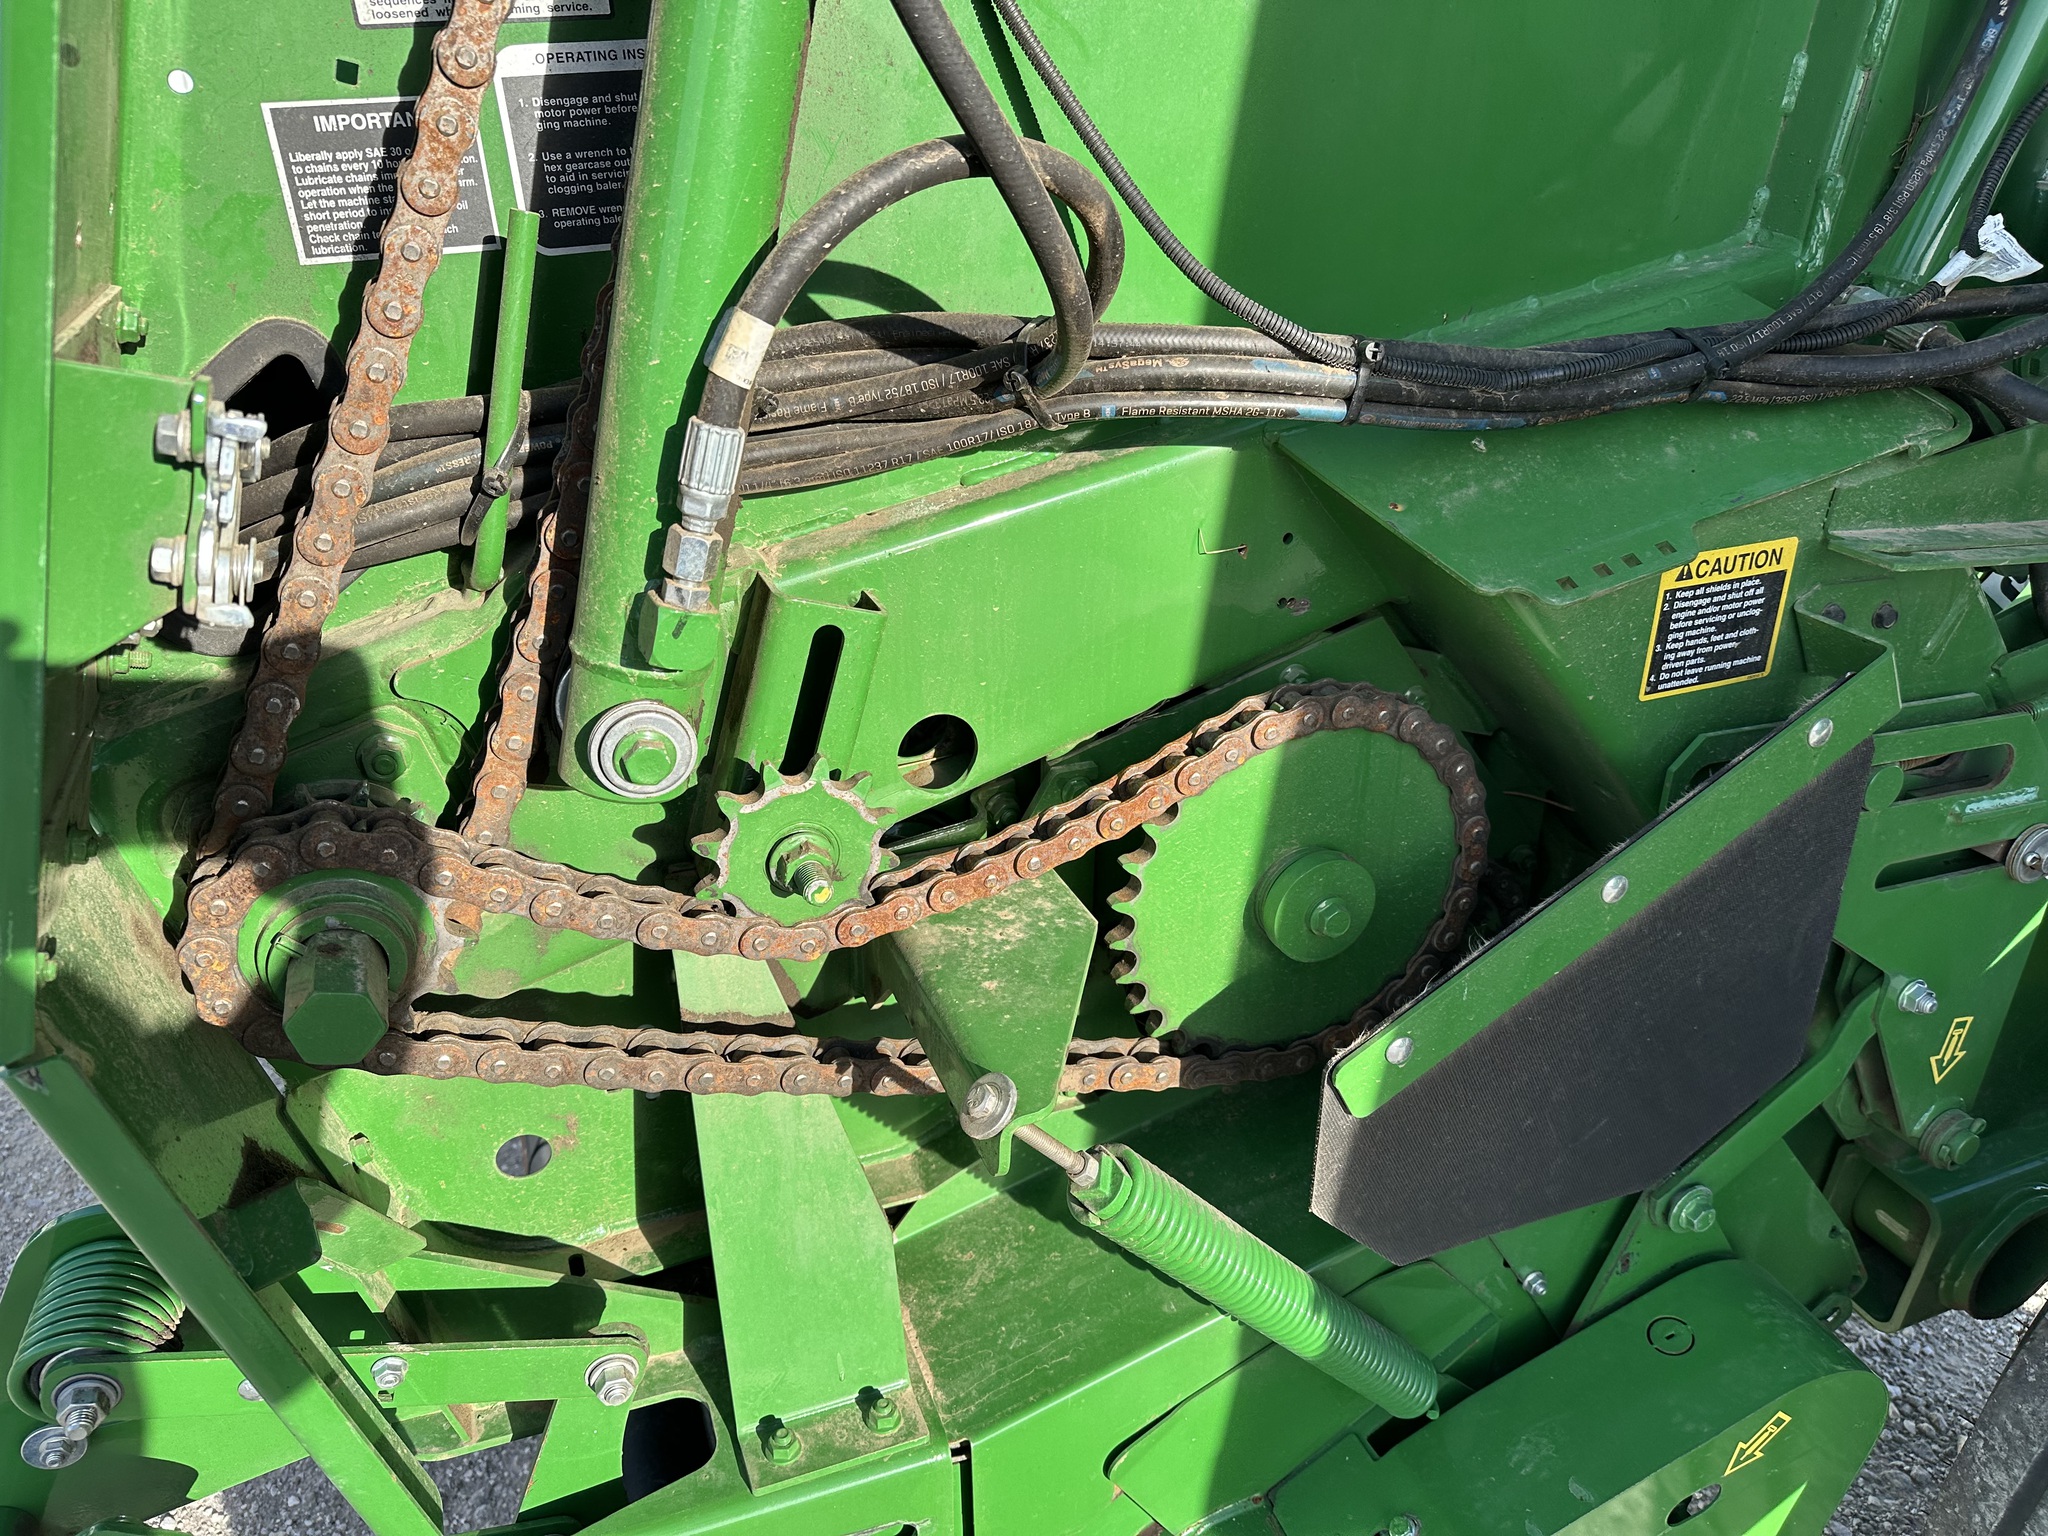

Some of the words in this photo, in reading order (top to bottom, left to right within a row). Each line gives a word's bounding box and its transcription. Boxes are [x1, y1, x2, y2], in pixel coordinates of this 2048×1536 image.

[371, 7, 429, 19] loosened
[547, 1, 593, 13] service.
[535, 49, 618, 64] OPERATING
[518, 98, 529, 108] 1.
[531, 94, 589, 108] Disengage
[592, 93, 611, 104] and
[615, 91, 638, 102] shut
[534, 107, 566, 119] motor
[569, 107, 601, 118] power
[605, 104, 638, 115] before
[536, 120, 560, 131] ging
[563, 117, 612, 129] machine.
[1932, 128, 1948, 150] 22.5
[288, 151, 333, 164] Liberally
[335, 150, 363, 162] apply
[365, 147, 388, 158] SAE
[390, 146, 402, 157] 30
[528, 153, 538, 162] 2.
[541, 152, 562, 161] Use
[565, 152, 572, 160] a
[575, 148, 613, 158] wrench
[616, 147, 627, 156] to
[1919, 149, 1937, 166] MPa
[291, 164, 303, 175] to
[305, 161, 339, 174] chains
[341, 161, 369, 173] every
[371, 159, 383, 169] 10
[544, 162, 563, 172] hex
[566, 158, 611, 172] gearcase
[295, 174, 343, 187] Lubricate
[344, 171, 379, 183] chains
[546, 173, 557, 183] to
[559, 171, 576, 182] aid
[579, 171, 589, 180] in
[298, 186, 346, 199] operation
[347, 183, 376, 194] when
[378, 182, 394, 192] the
[548, 181, 594, 195] clogging
[596, 180, 625, 190] baler.
[301, 199, 318, 210] Let
[318, 197, 335, 209] the
[336, 195, 380, 208] machine
[303, 209, 332, 221] short
[333, 206, 366, 222] period
[367, 207, 378, 217] to
[456, 200, 469, 210] oil
[538, 209, 548, 219] 3.
[552, 206, 597, 217] REMOVE
[599, 205, 624, 215] wren
[306, 220, 367, 234] penetration.
[554, 217, 600, 229] operating
[309, 232, 341, 244] Check
[343, 230, 370, 242] chain
[311, 241, 368, 256] lubrication.
[1808, 291, 1824, 306] R17
[1786, 308, 1803, 322] SAE
[990, 357, 1011, 373] SAE
[950, 363, 987, 385] 100R17
[885, 382, 919, 399] 18752
[921, 378, 940, 392] ISO
[848, 396, 856, 407] B
[859, 389, 885, 403] Type
[793, 402, 828, 414] Flame
[832, 468, 851, 480] ISO
[854, 460, 888, 474] 11237
[891, 453, 912, 466] R17
[922, 445, 944, 458] SAE
[996, 424, 1015, 438] ISO
[1055, 410, 1081, 422] Type
[1082, 408, 1091, 419] B
[1121, 406, 1157, 417] Flame
[1159, 405, 1210, 417] Resistant
[1211, 406, 1243, 417] MSHA
[1245, 406, 1286, 418] 2G-11C
[1695, 547, 1784, 579] CAUTION
[1675, 589, 1694, 600] Keep
[1695, 587, 1705, 595] all
[1705, 583, 1731, 594] shields
[1732, 581, 1740, 589] in
[1741, 578, 1762, 589] place.
[1673, 597, 1711, 610] Disengage
[1712, 595, 1726, 604] and
[1727, 591, 1743, 601] shut
[1744, 589, 1755, 598] off
[1755, 586, 1764, 595] all
[1671, 609, 1696, 620] engine
[1697, 605, 1720, 616] and/or
[1721, 601, 1742, 611] motor
[1743, 597, 1766, 609] power
[1669, 619, 1693, 630] before
[1694, 614, 1727, 626] servicing
[1728, 612, 1736, 620] or
[1737, 607, 1763, 619] unclog-
[1655, 644, 1662, 652] 3.
[1665, 641, 1684, 651] Keep
[1685, 636, 1709, 647] hands,
[1710, 633, 1723, 643] feet
[1725, 631, 1738, 639] and
[1739, 626, 1759, 637] cloth-
[1667, 630, 1684, 642] ging
[1685, 625, 1717, 637] machine.
[1663, 652, 1675, 661] ing
[1676, 648, 1695, 658] away
[1696, 645, 1713, 654] from
[1649, 674, 1656, 682] 4.
[1659, 671, 1670, 680] Do
[1671, 669, 1684, 678] not
[1684, 665, 1704, 675] leave
[1704, 660, 1731, 672] running
[1732, 655, 1762, 667] machine
[1661, 660, 1685, 671] driven
[1685, 657, 1706, 668] parts.
[1657, 676, 1699, 690] unattended.
